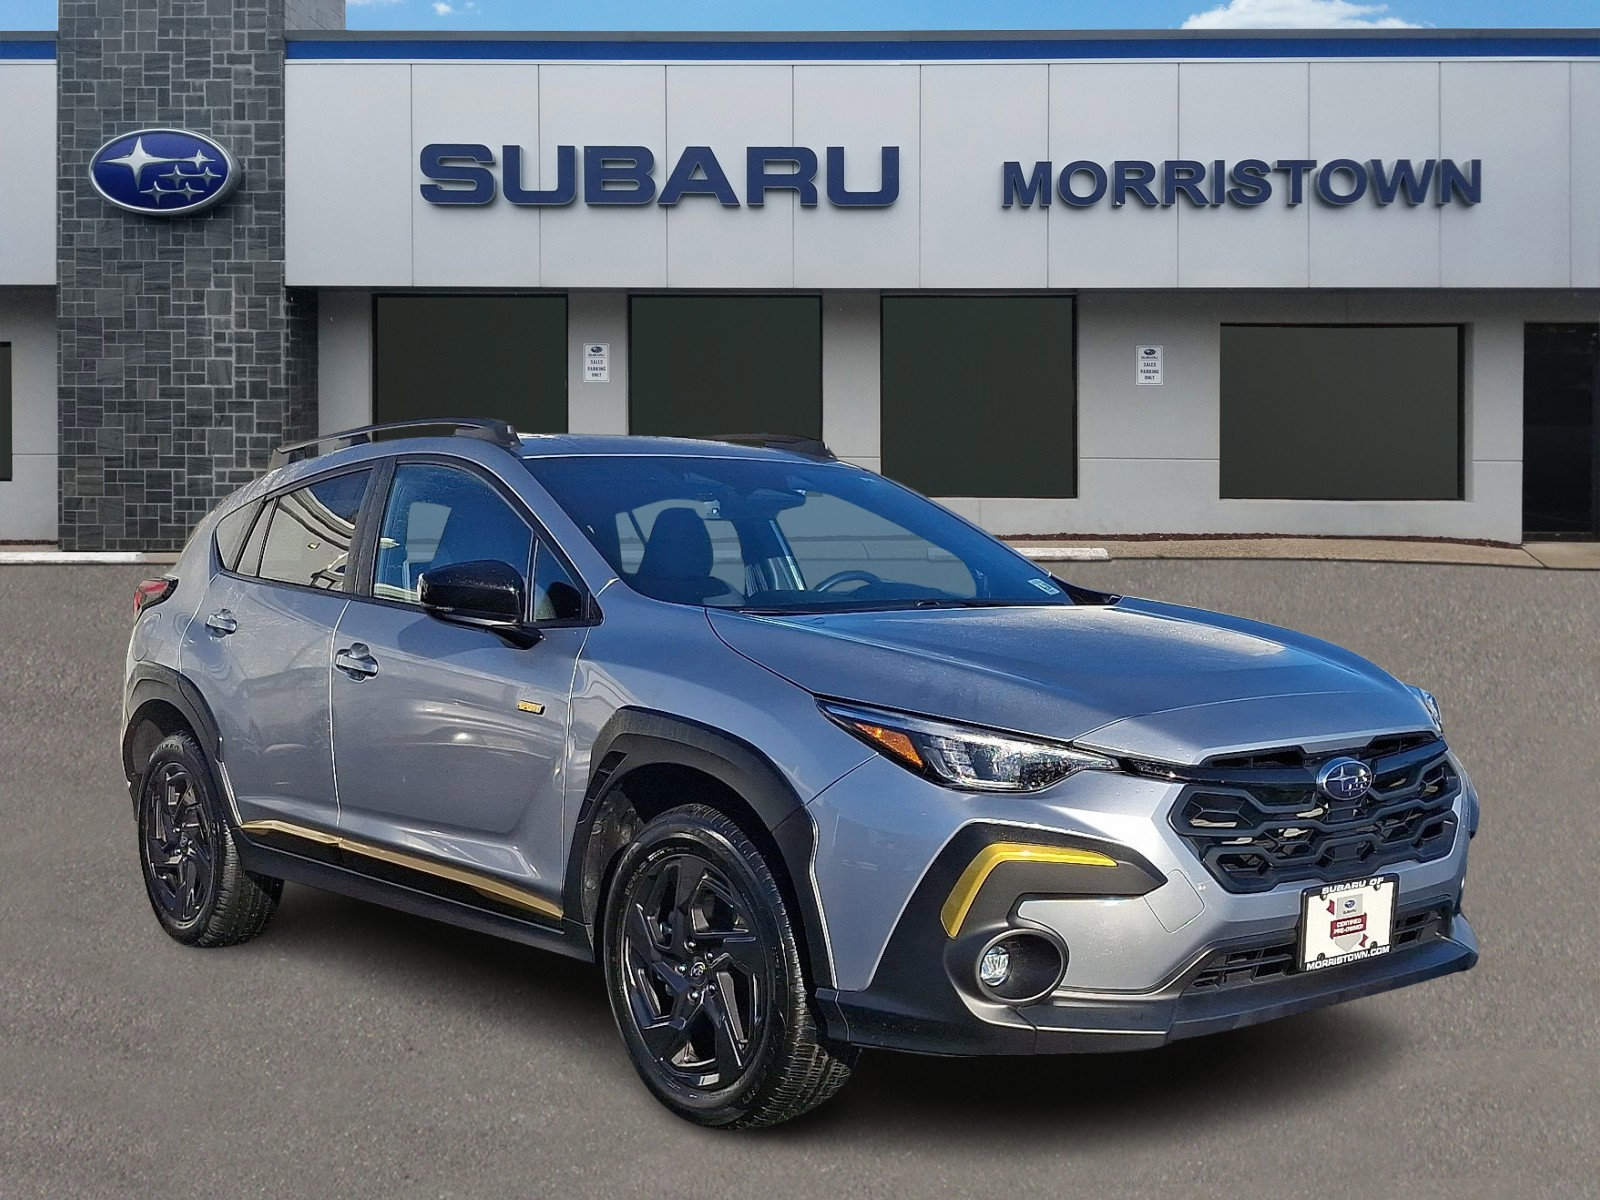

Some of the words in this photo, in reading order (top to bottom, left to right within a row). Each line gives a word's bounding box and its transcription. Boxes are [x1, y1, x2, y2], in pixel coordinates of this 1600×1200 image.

[419, 143, 900, 206] SUBARU
[1002, 158, 1482, 207] MORRISTOWN
[1322, 880, 1366, 894] SUBARU
[1369, 877, 1384, 885] OF
[1306, 945, 1390, 971] MORRISTOWN.COM
